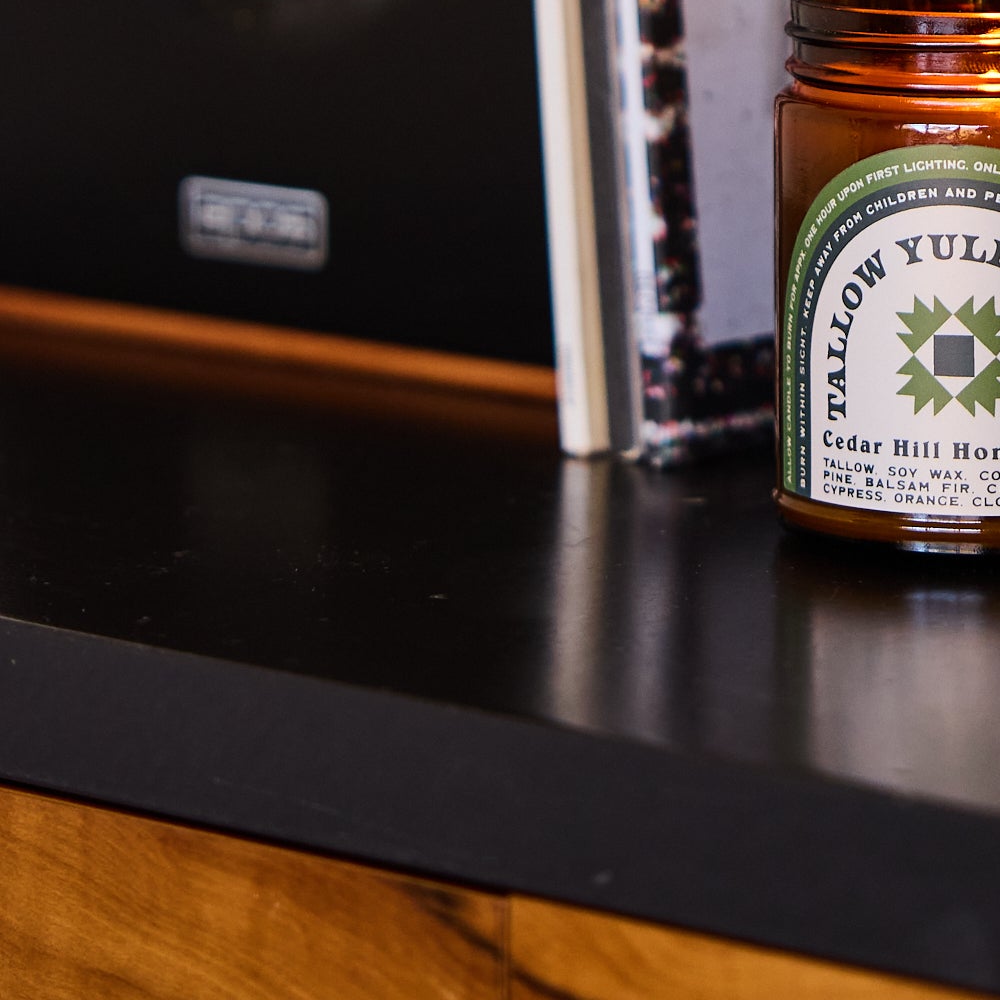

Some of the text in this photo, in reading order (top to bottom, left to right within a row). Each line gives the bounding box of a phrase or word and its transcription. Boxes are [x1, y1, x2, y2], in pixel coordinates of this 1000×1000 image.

[786, 354, 792, 371] TO
[789, 283, 797, 310] FOR
[804, 223, 818, 248] ONE
[815, 198, 837, 226] HOUR
[836, 178, 865, 202] UPON
[865, 164, 900, 185] FIRST
[903, 159, 969, 173] LIGHTING.
[803, 279, 815, 319] KEEP
[814, 241, 834, 277] AWAY
[833, 211, 863, 242] FROM
[865, 187, 938, 215] CHILDREN
[945, 187, 977, 199] AND
[827, 248, 887, 421] TALLOW
[823, 429, 883, 454] Cedar
[893, 438, 940, 459] Hill
[865, 477, 930, 492] BALSAM
[888, 466, 918, 478] SOY
